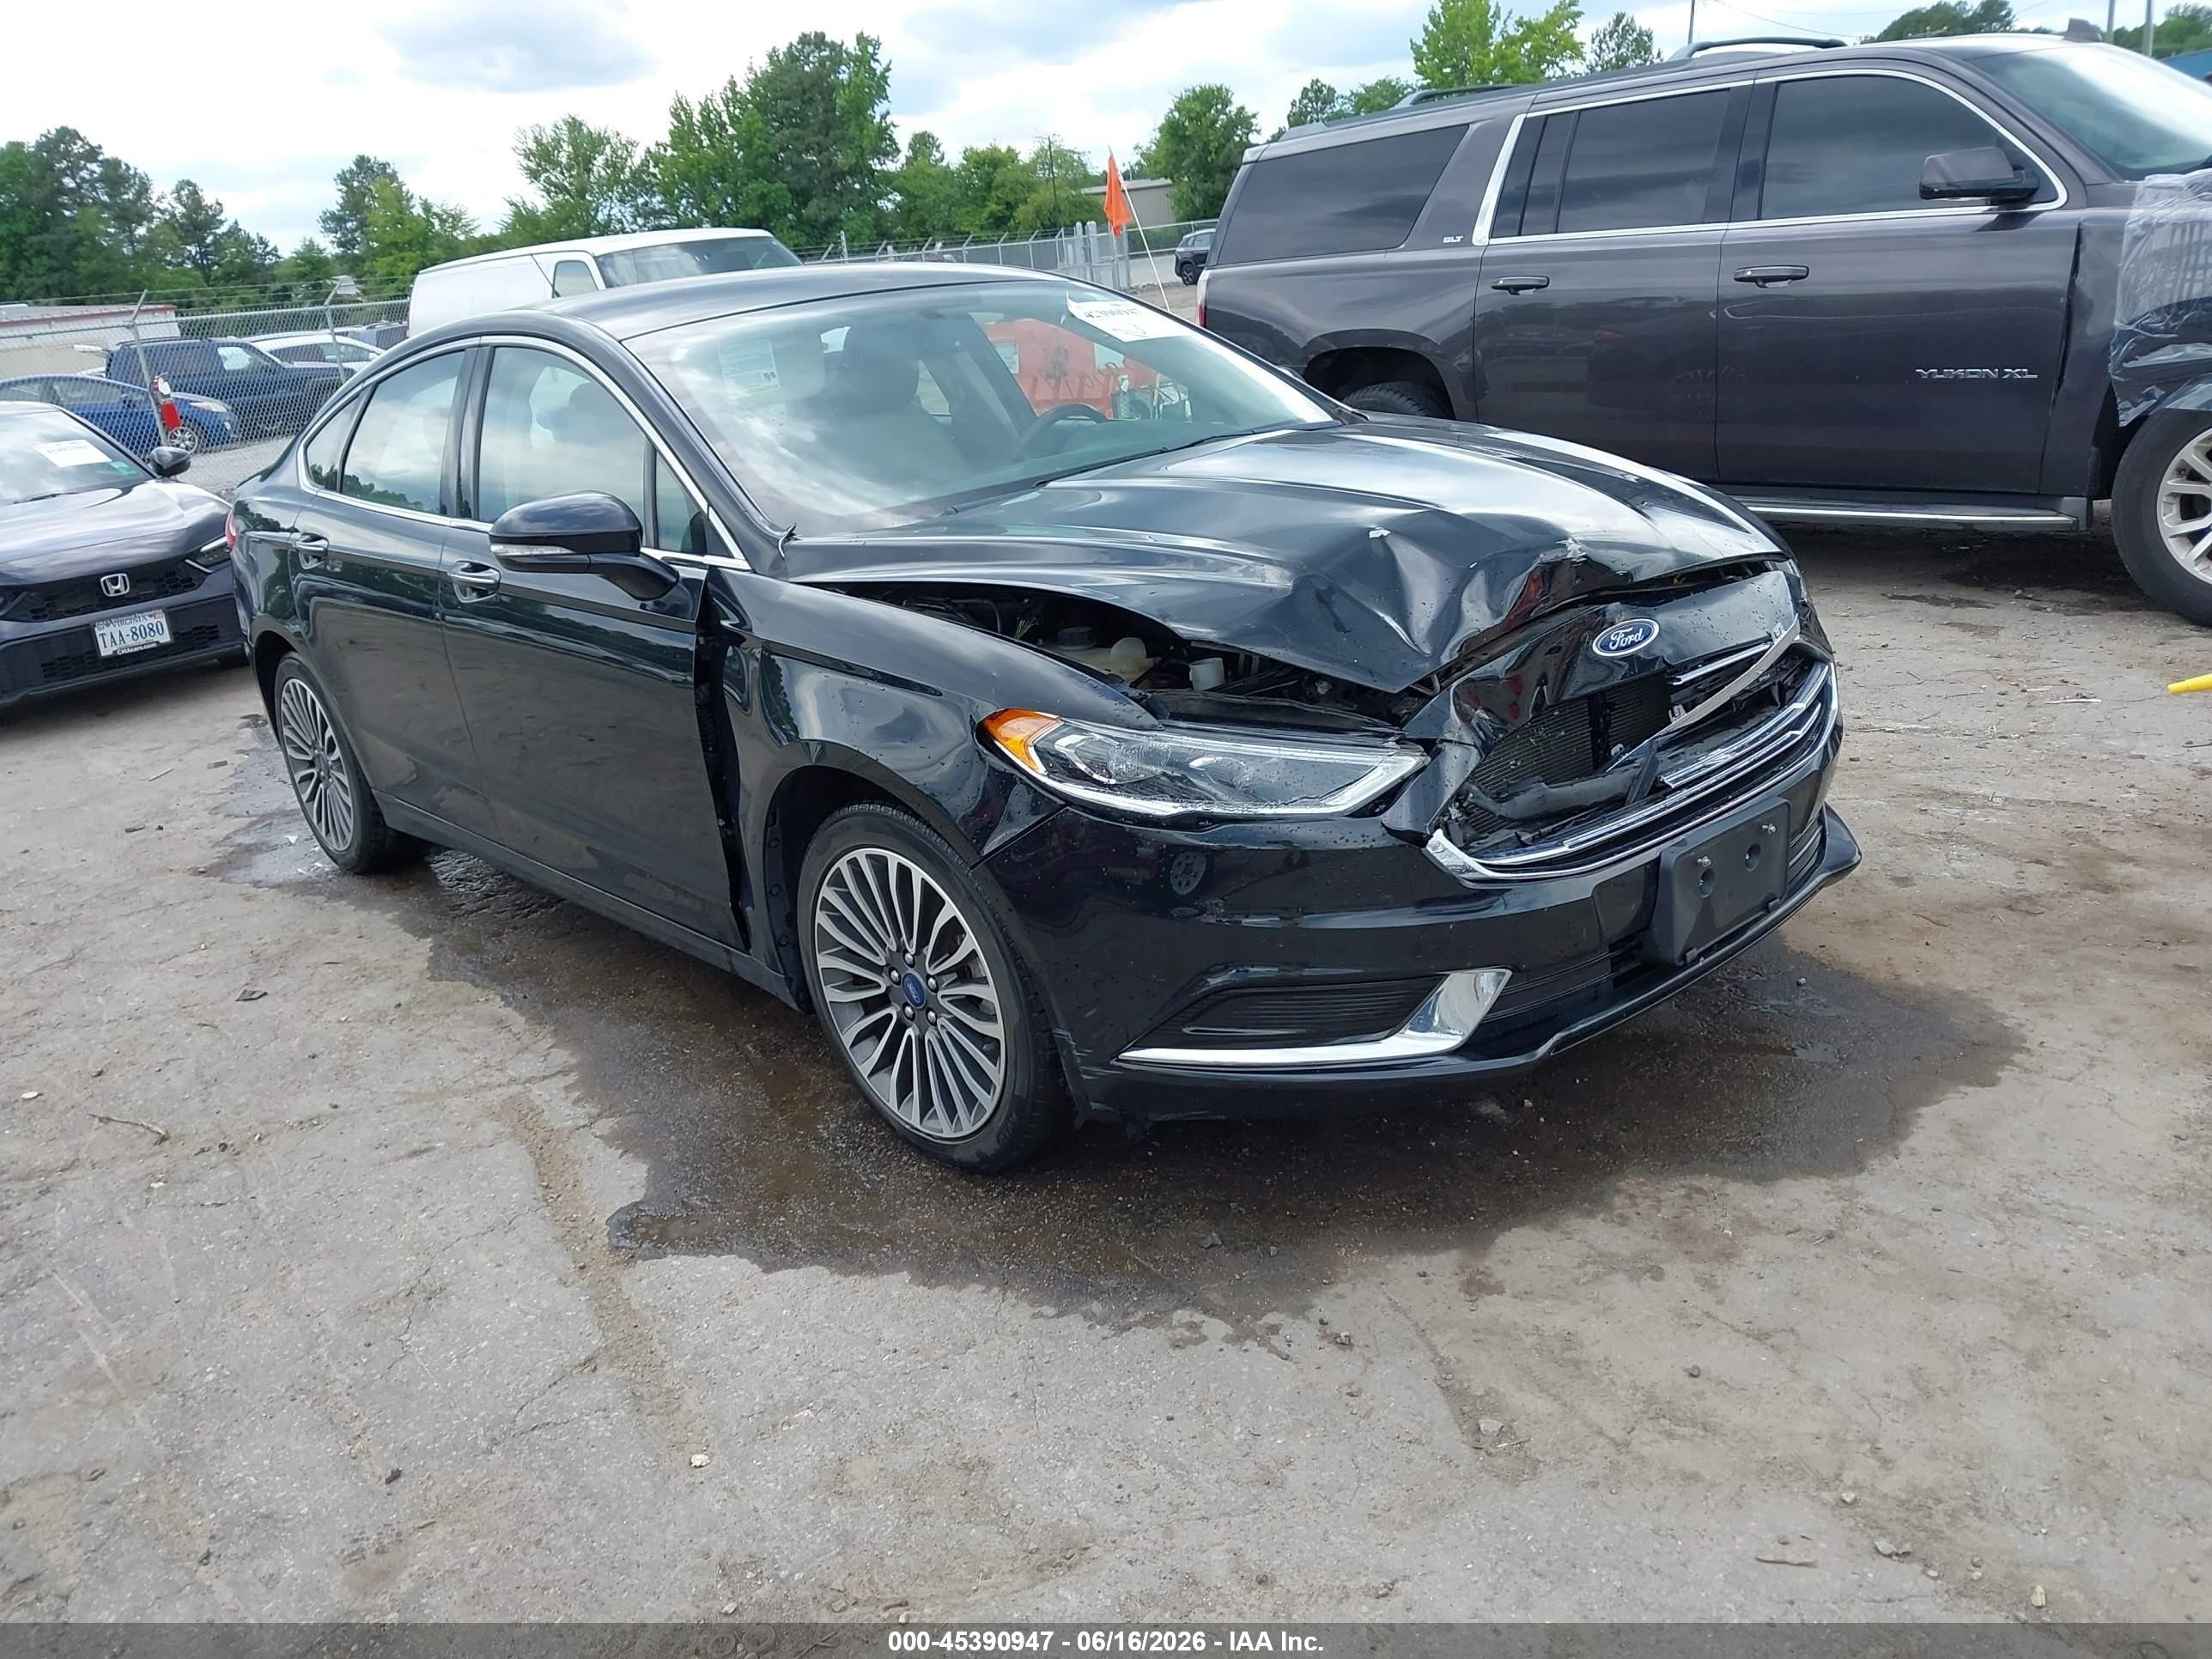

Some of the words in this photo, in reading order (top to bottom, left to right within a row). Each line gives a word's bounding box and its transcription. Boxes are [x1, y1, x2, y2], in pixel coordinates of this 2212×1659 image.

[1915, 368, 1999, 379] YUKON
[2002, 368, 2038, 379] XL
[99, 621, 164, 648] TAA-8080
[1608, 627, 1644, 650] Ford
